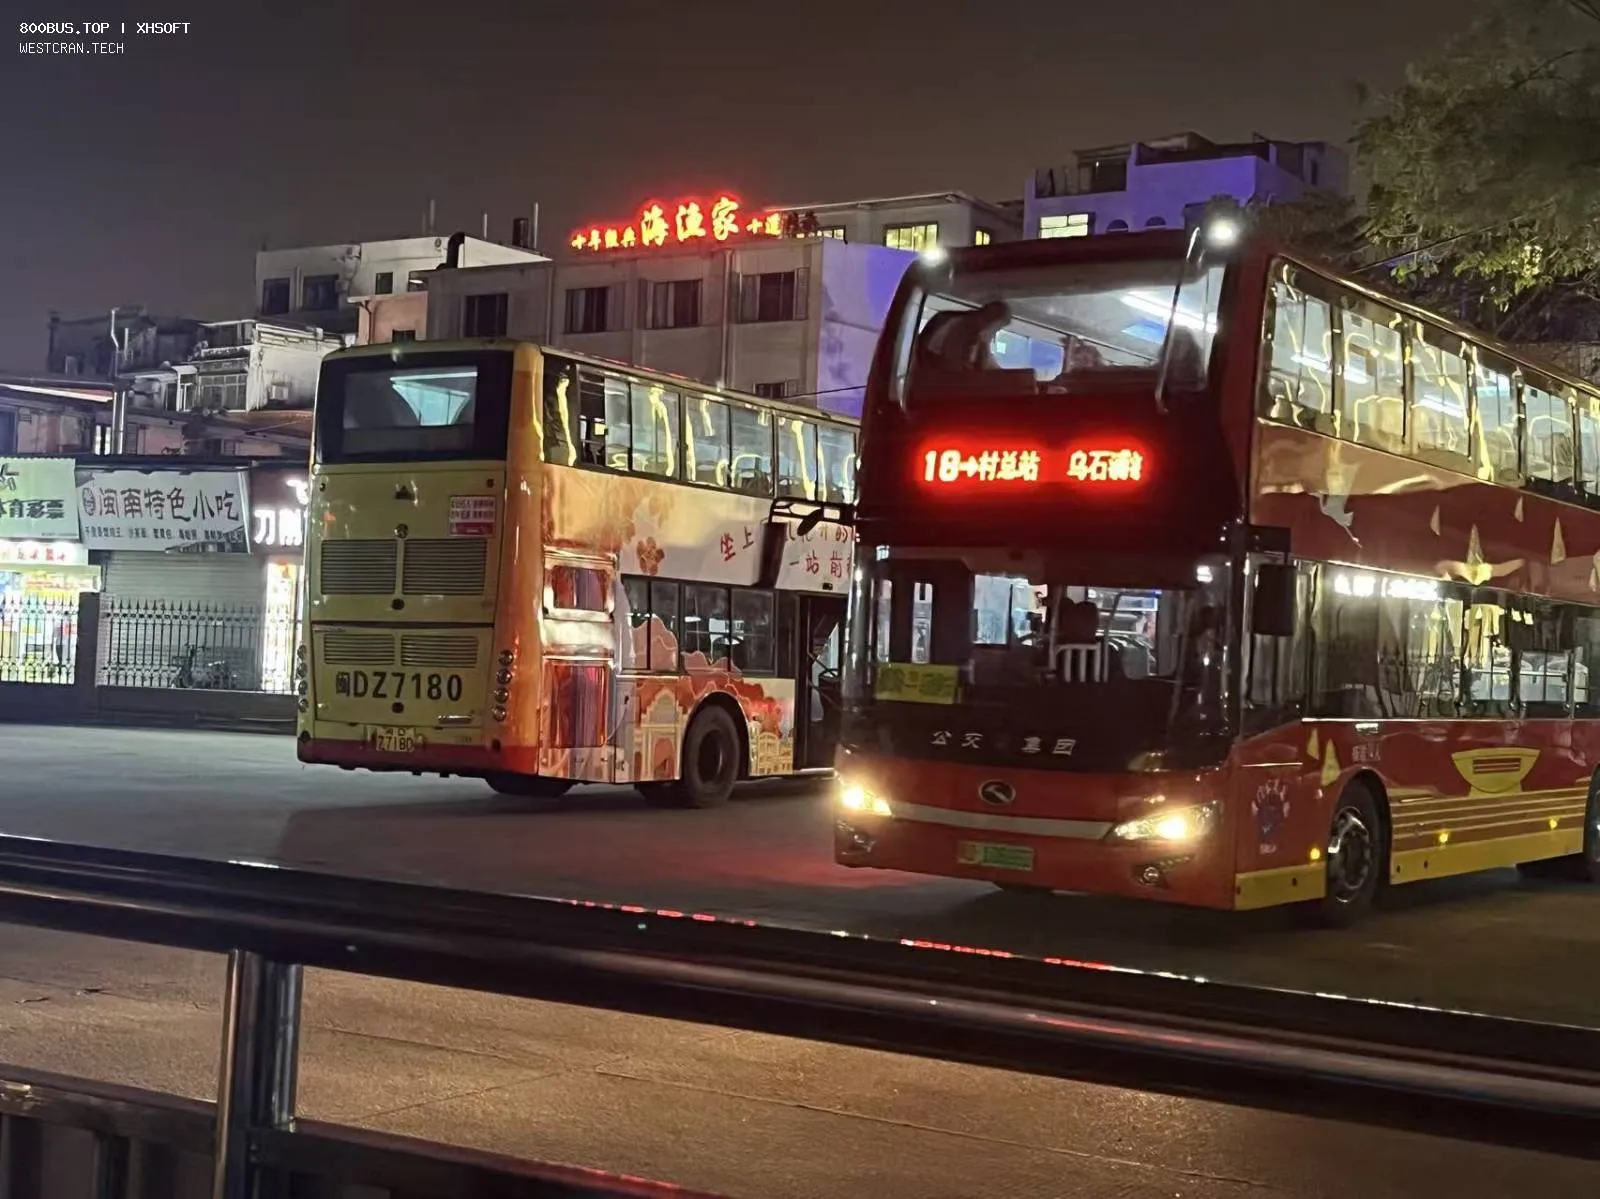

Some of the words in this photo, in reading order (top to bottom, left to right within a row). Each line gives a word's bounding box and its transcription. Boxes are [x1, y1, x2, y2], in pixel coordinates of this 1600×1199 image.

[924, 449, 961, 482] 18
[99, 486, 240, 523] 闽南特色小吃
[930, 729, 985, 750] 公交
[1021, 735, 1077, 756] 集团
